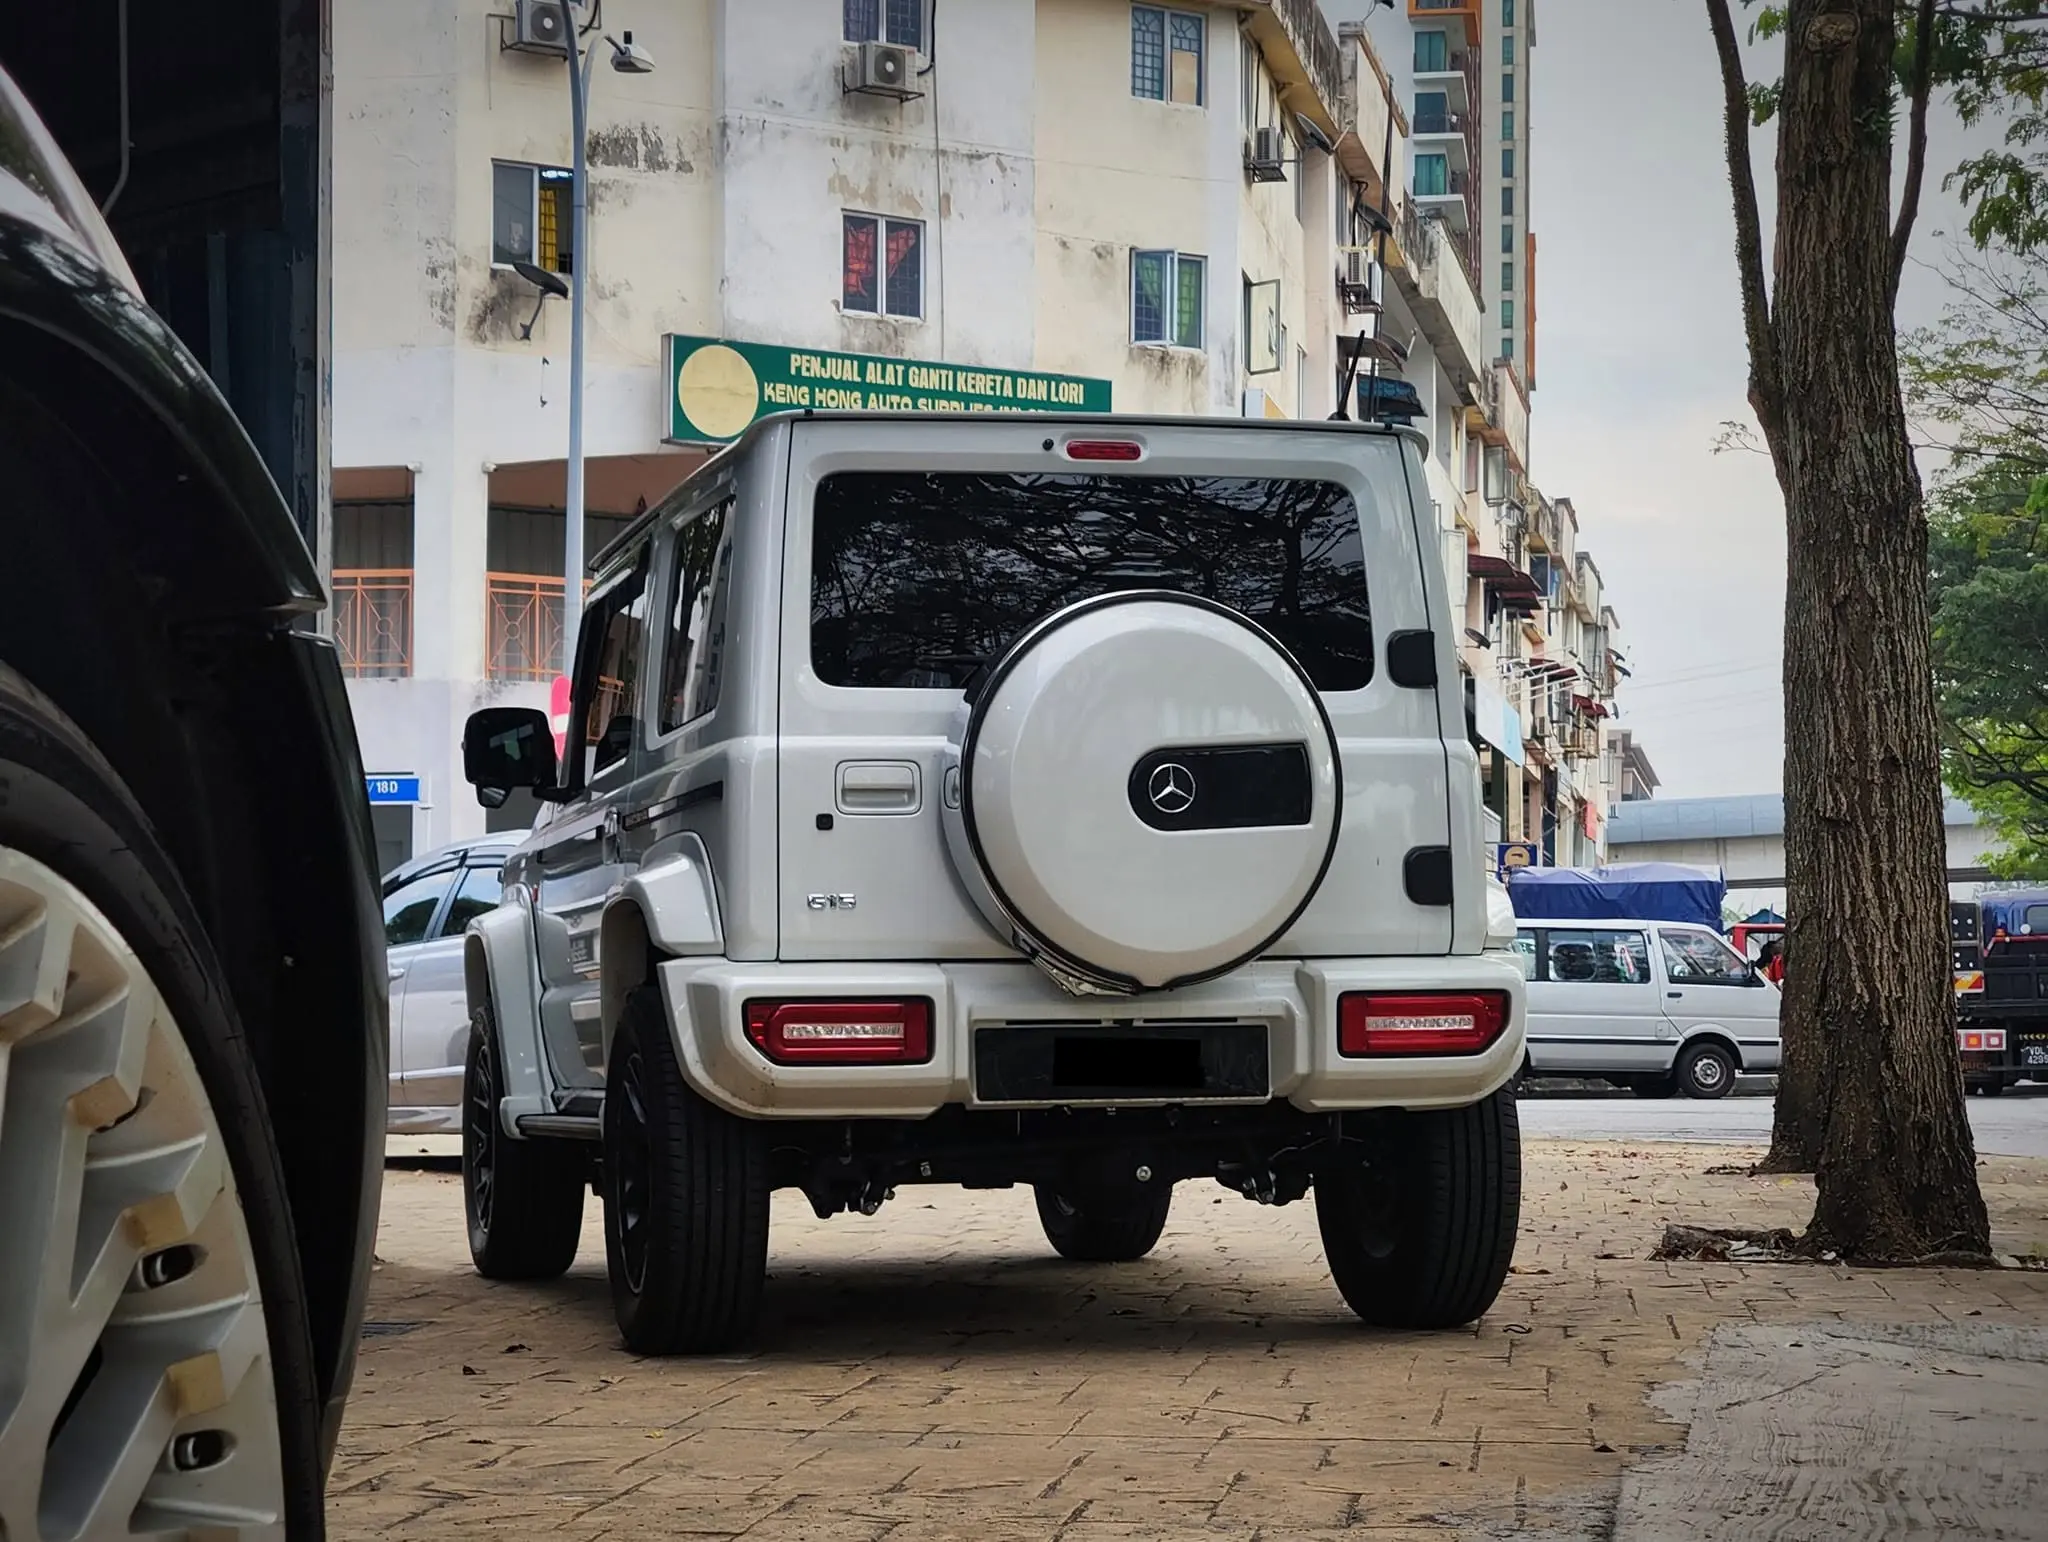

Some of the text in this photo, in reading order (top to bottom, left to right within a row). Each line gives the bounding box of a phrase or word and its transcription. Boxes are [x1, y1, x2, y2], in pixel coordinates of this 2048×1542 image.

[764, 381, 810, 405] KENG
[814, 387, 861, 409] HONG
[867, 392, 912, 410] AUTO
[790, 353, 1084, 405] PENJUAL ALAT GANTI KERETA DAN LORI
